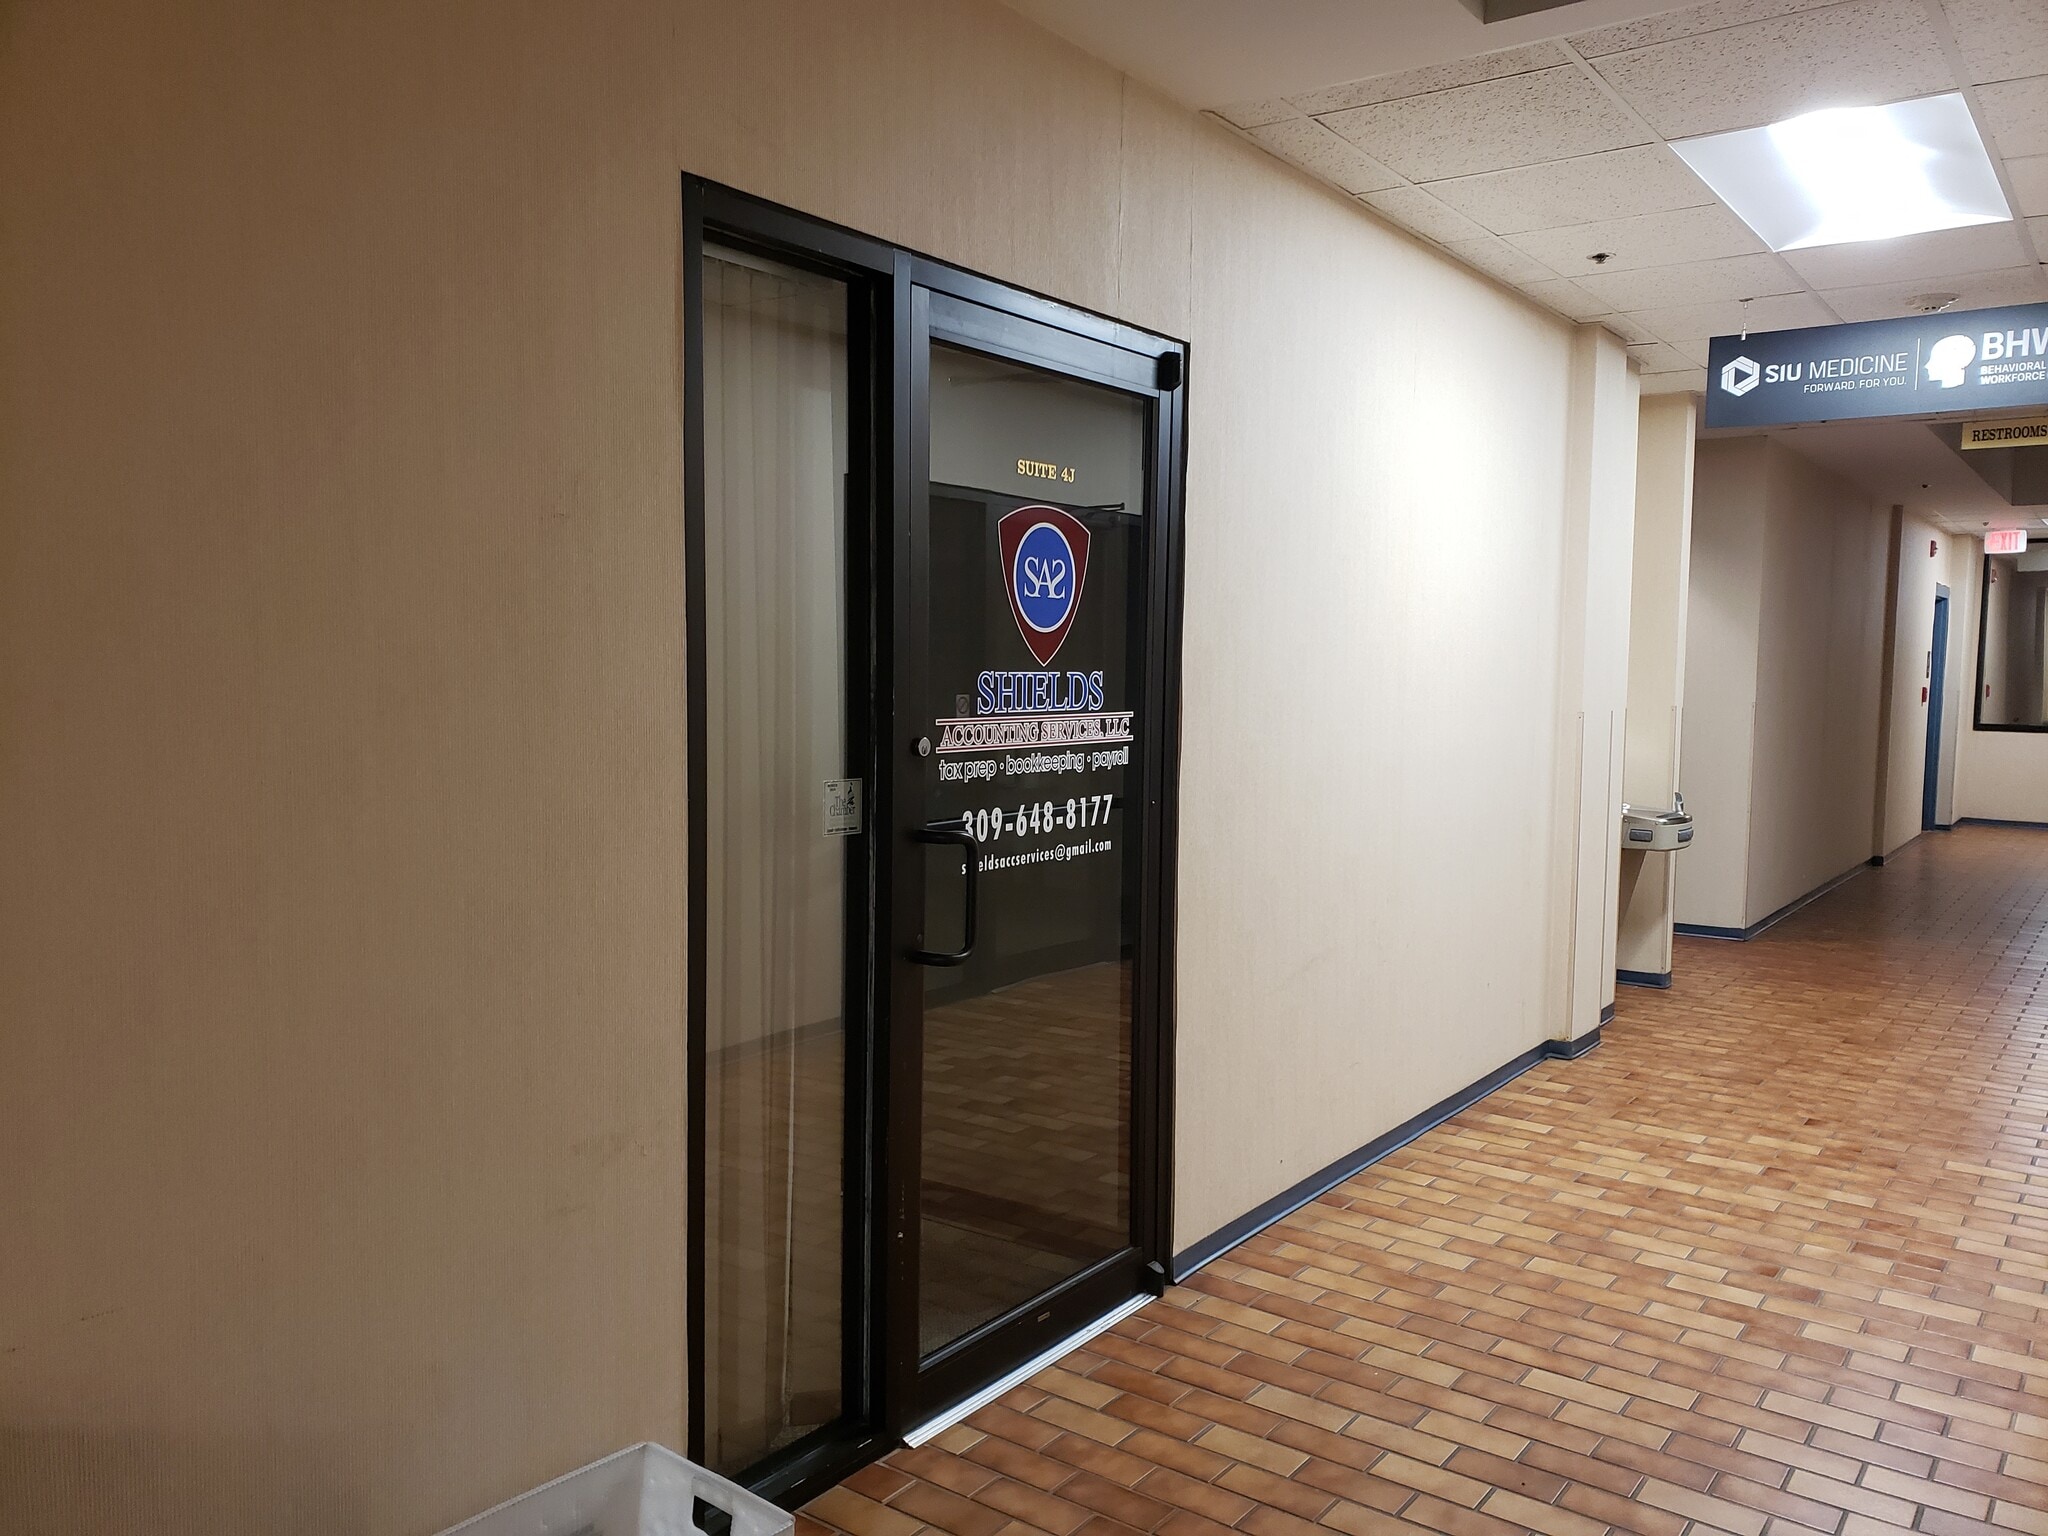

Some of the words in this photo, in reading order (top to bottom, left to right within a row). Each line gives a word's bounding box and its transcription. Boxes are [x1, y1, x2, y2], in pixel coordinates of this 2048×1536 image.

[1765, 362, 1802, 384] SIU
[1809, 352, 1908, 380] MEDICINE
[1980, 361, 2047, 375] BEHAVIORAL
[1980, 371, 2046, 385] WORKFORCE
[1803, 380, 1857, 394] FORWARD.
[1859, 378, 1881, 389] FOR
[1883, 375, 1907, 387] YOU.
[1972, 425, 2048, 442] RESTROOMS
[1017, 458, 1057, 480] SUITE
[1060, 467, 1076, 483] 4J
[977, 670, 1104, 715] SHIELDS
[940, 722, 1040, 747] ACCOUNTING
[1106, 717, 1130, 736] LLC
[939, 759, 963, 781] tax
[963, 758, 997, 783] prep
[1005, 750, 1085, 775] bookkeeping
[1092, 746, 1129, 770] payroll
[962, 794, 1113, 843] 309-648-8177
[961, 838, 1112, 875] seldsaccservices@gmail.com
